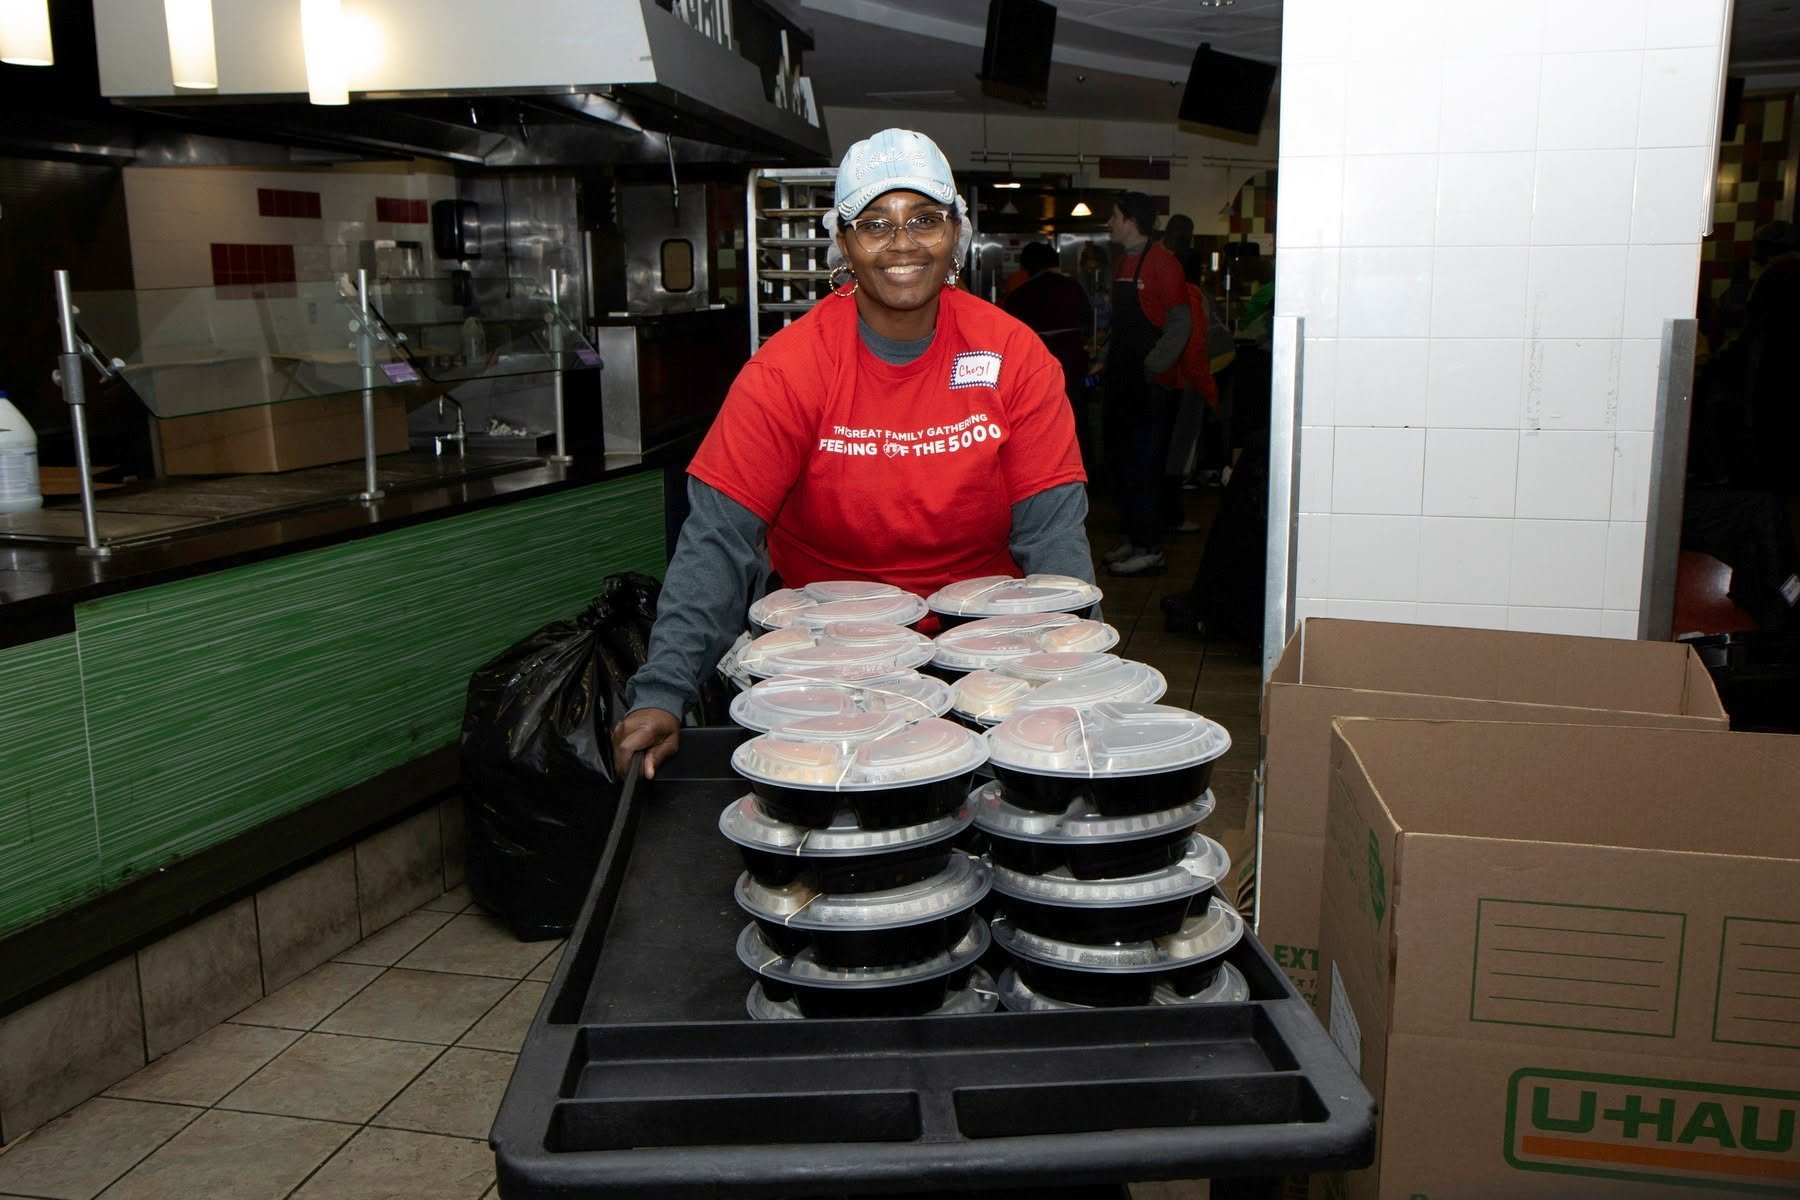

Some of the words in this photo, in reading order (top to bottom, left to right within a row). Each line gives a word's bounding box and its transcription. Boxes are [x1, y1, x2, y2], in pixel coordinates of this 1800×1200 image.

[958, 361, 991, 377] Cheryl
[819, 439, 878, 456] FEEING
[912, 440, 945, 456] THE
[948, 423, 1001, 452] 5000
[845, 429, 882, 438] GREAT
[885, 429, 924, 441] FAMILY
[926, 413, 988, 437] GATHERING
